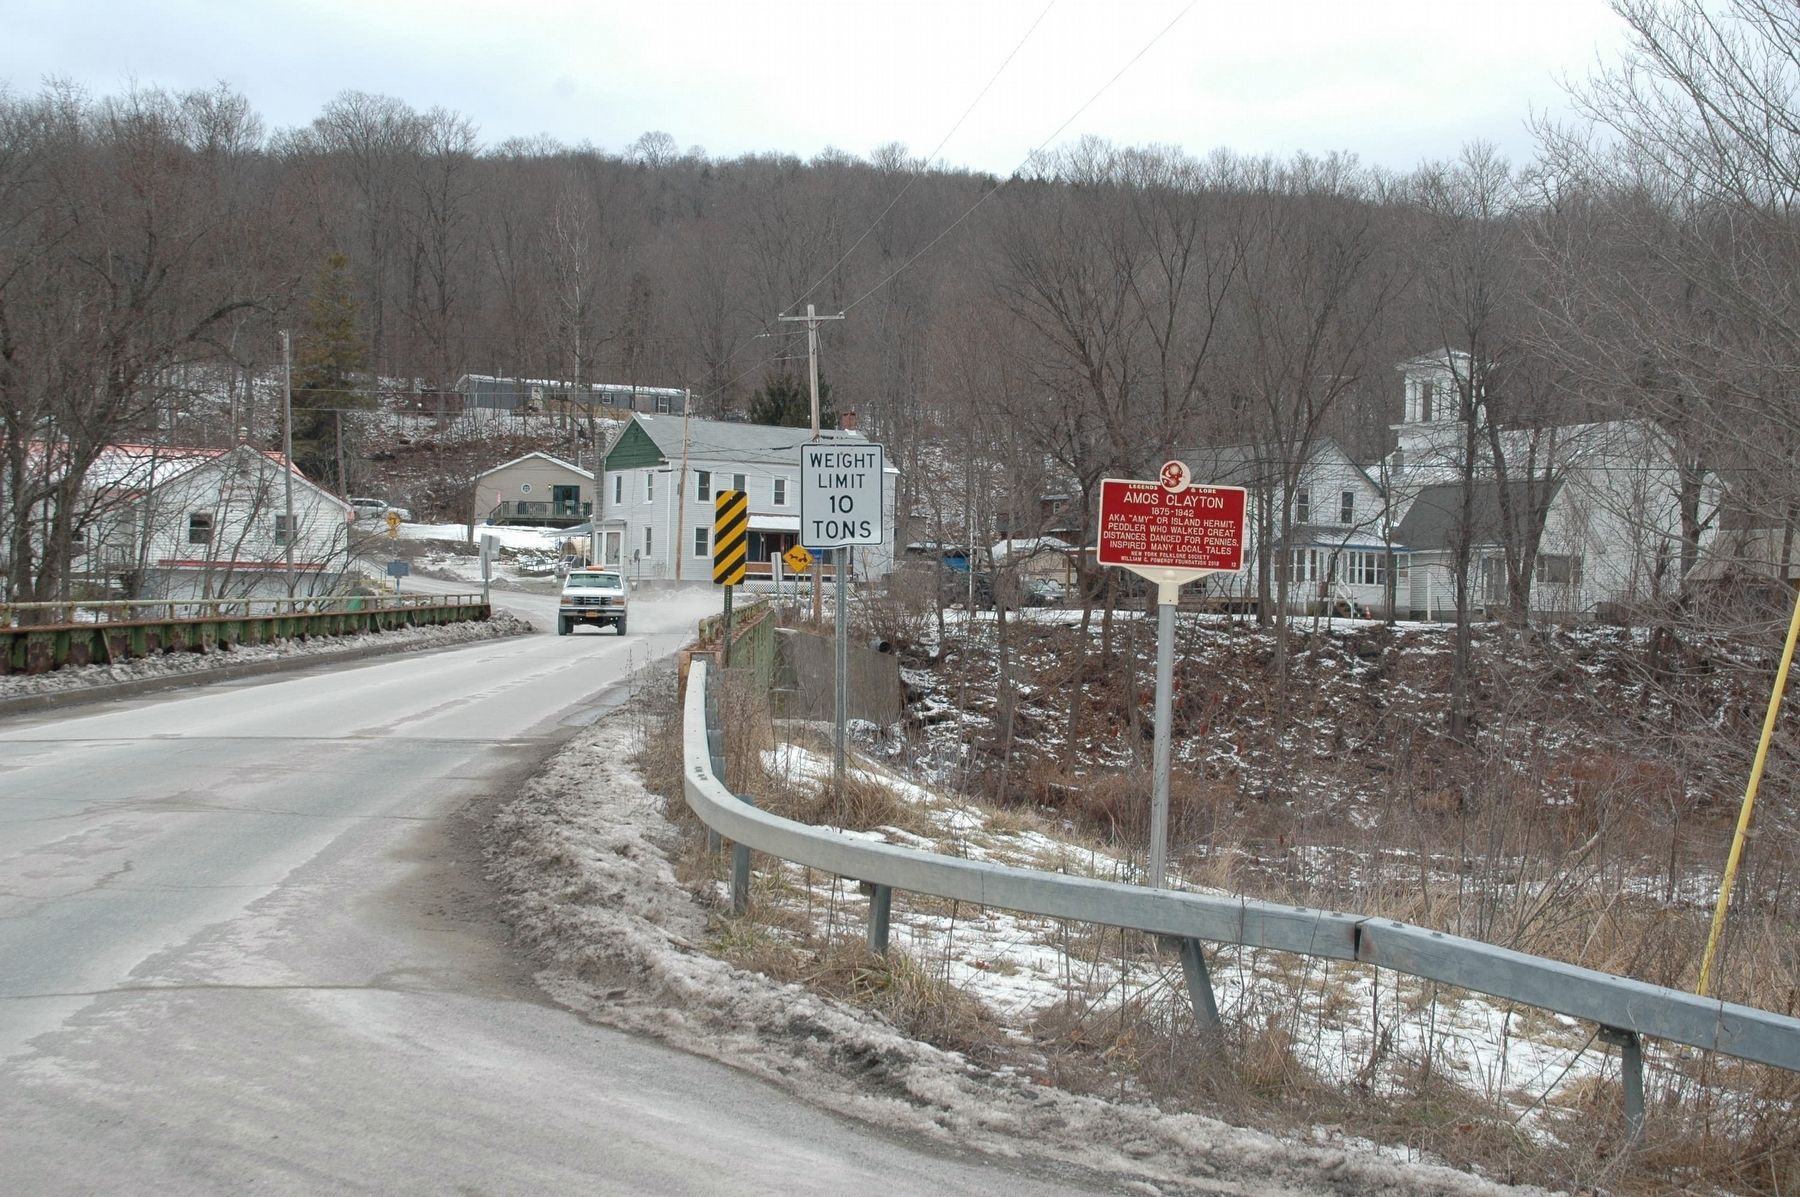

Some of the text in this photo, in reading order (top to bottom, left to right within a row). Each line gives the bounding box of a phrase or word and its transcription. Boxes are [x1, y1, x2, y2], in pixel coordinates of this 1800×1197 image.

[810, 453, 875, 468] WEIGHT
[818, 473, 865, 489] LIMIT
[829, 495, 853, 513] 10
[1123, 491, 1224, 509] AMOS CLAYTON
[1108, 513, 1126, 522] AKA
[1156, 517, 1168, 525] OR
[1171, 517, 1201, 526] ISLAND
[812, 520, 871, 539] TONS
[1108, 522, 1235, 537] PEDDLER WHO WALKED GREAT
[1150, 534, 1182, 543] DANCED
[1184, 536, 1201, 544] FOR
[1109, 540, 1232, 555] INSPIRED MANY LOCAL TALES
